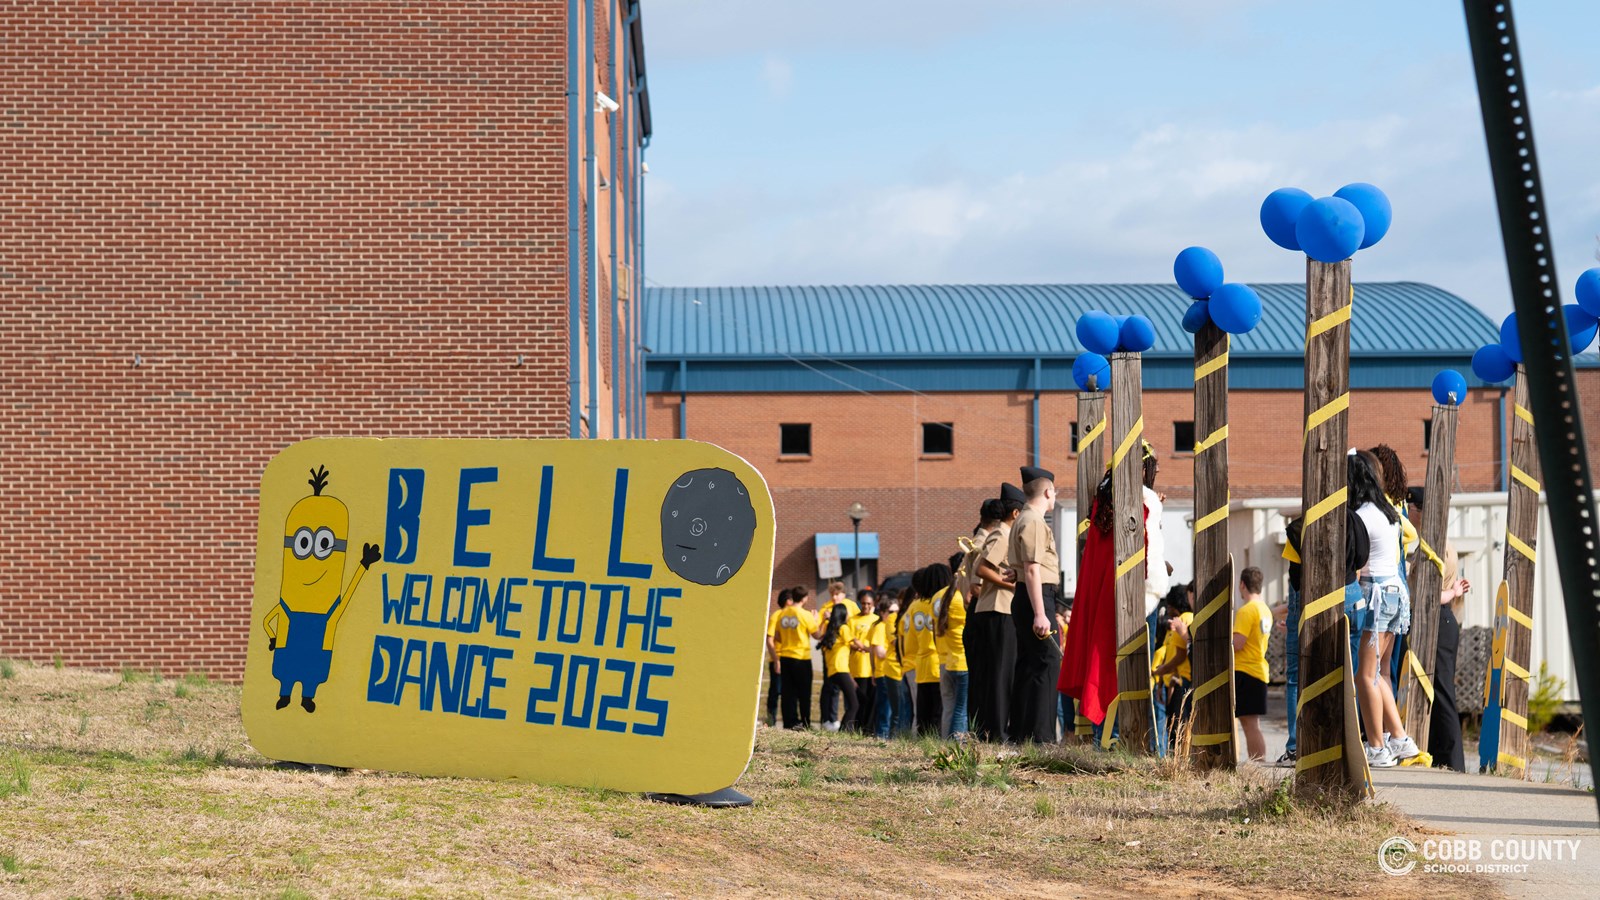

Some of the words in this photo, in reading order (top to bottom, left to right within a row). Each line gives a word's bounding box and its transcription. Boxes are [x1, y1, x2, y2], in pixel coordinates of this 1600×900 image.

[384, 466, 653, 580] BELL
[382, 573, 528, 639] WELCOME
[533, 579, 587, 644] TO
[590, 583, 682, 654] THE
[367, 635, 514, 720] DANCE
[526, 651, 675, 737] 2025
